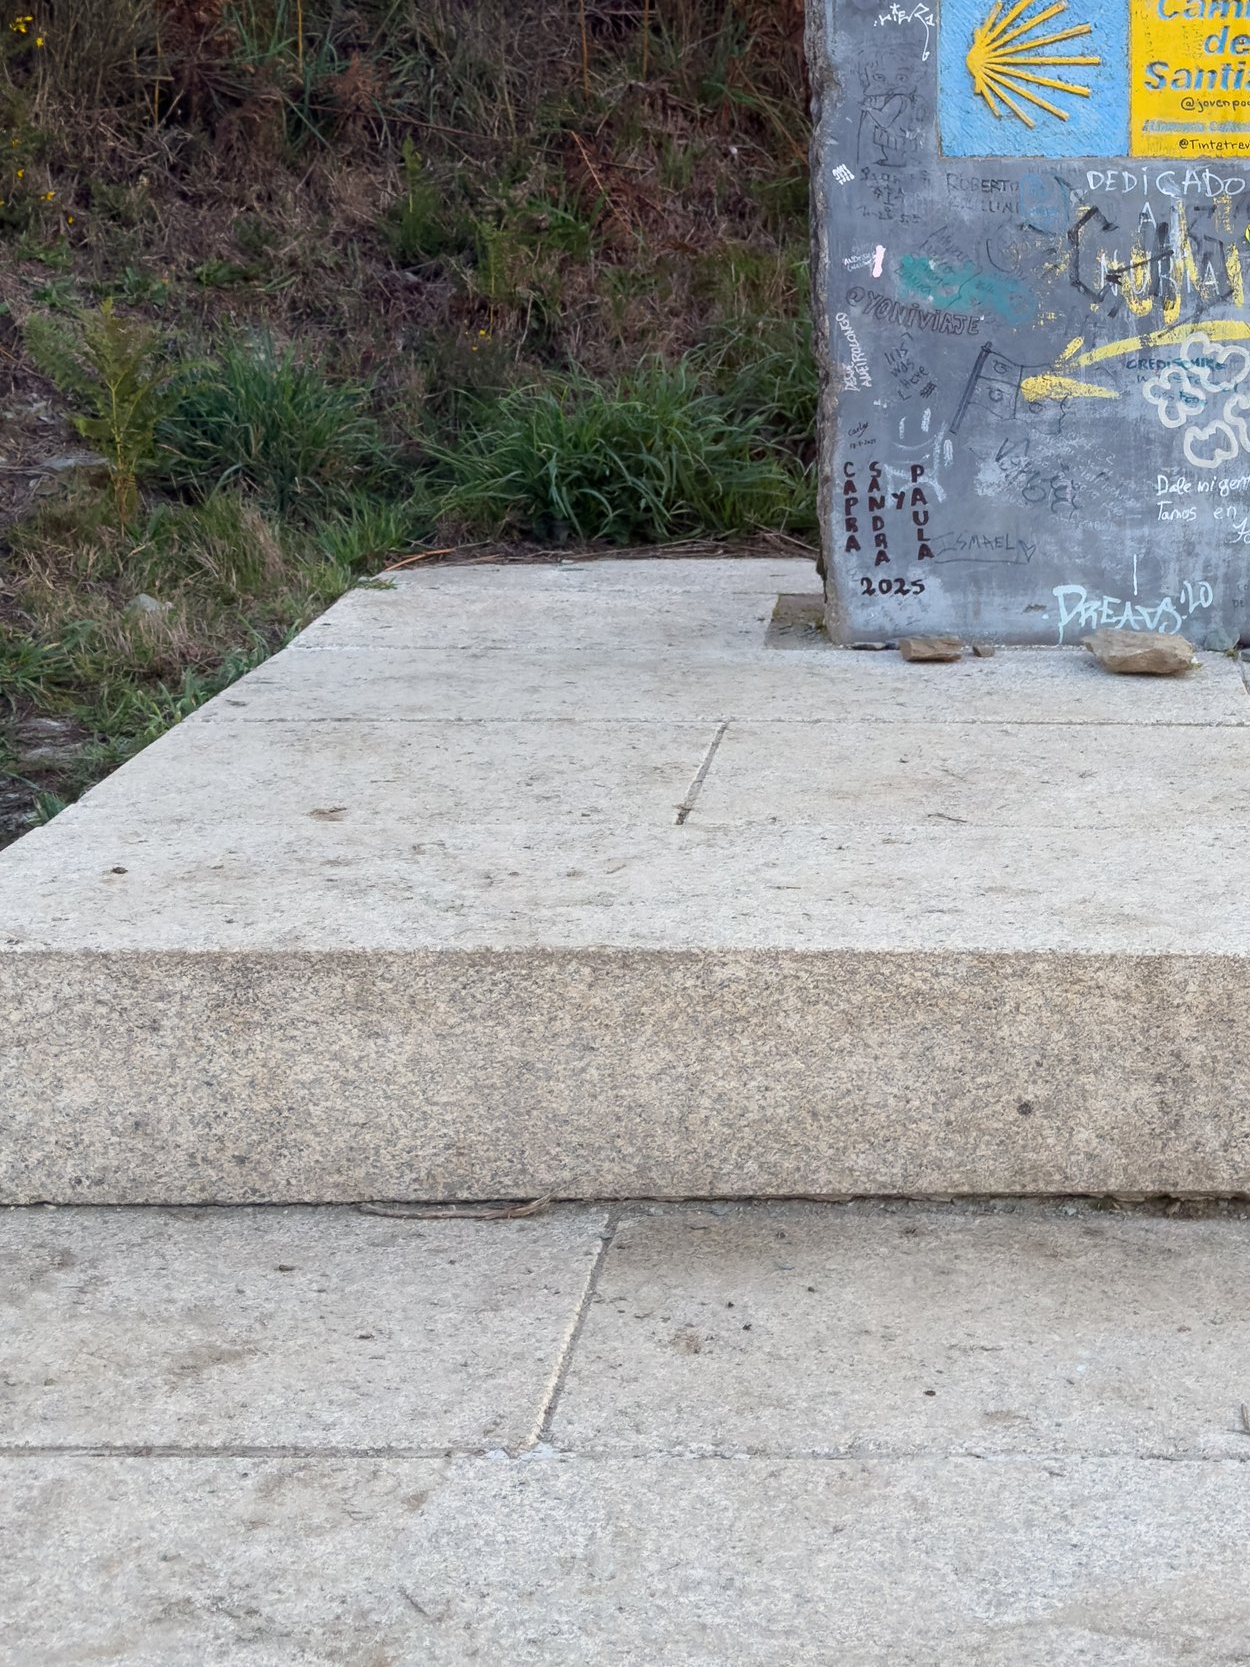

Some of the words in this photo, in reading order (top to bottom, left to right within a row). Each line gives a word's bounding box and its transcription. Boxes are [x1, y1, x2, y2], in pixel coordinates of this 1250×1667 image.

[1086, 166, 1246, 199] DEDICADO
[1137, 201, 1158, 233] A
[890, 490, 907, 511] Y
[1156, 473, 1192, 497] Dale
[843, 461, 862, 553] CAPRA
[867, 460, 892, 567] SANDRA
[910, 463, 935, 562] PAULA
[1156, 500, 1198, 522] Tamos
[1212, 504, 1238, 520] en
[860, 576, 926, 598] 2025
